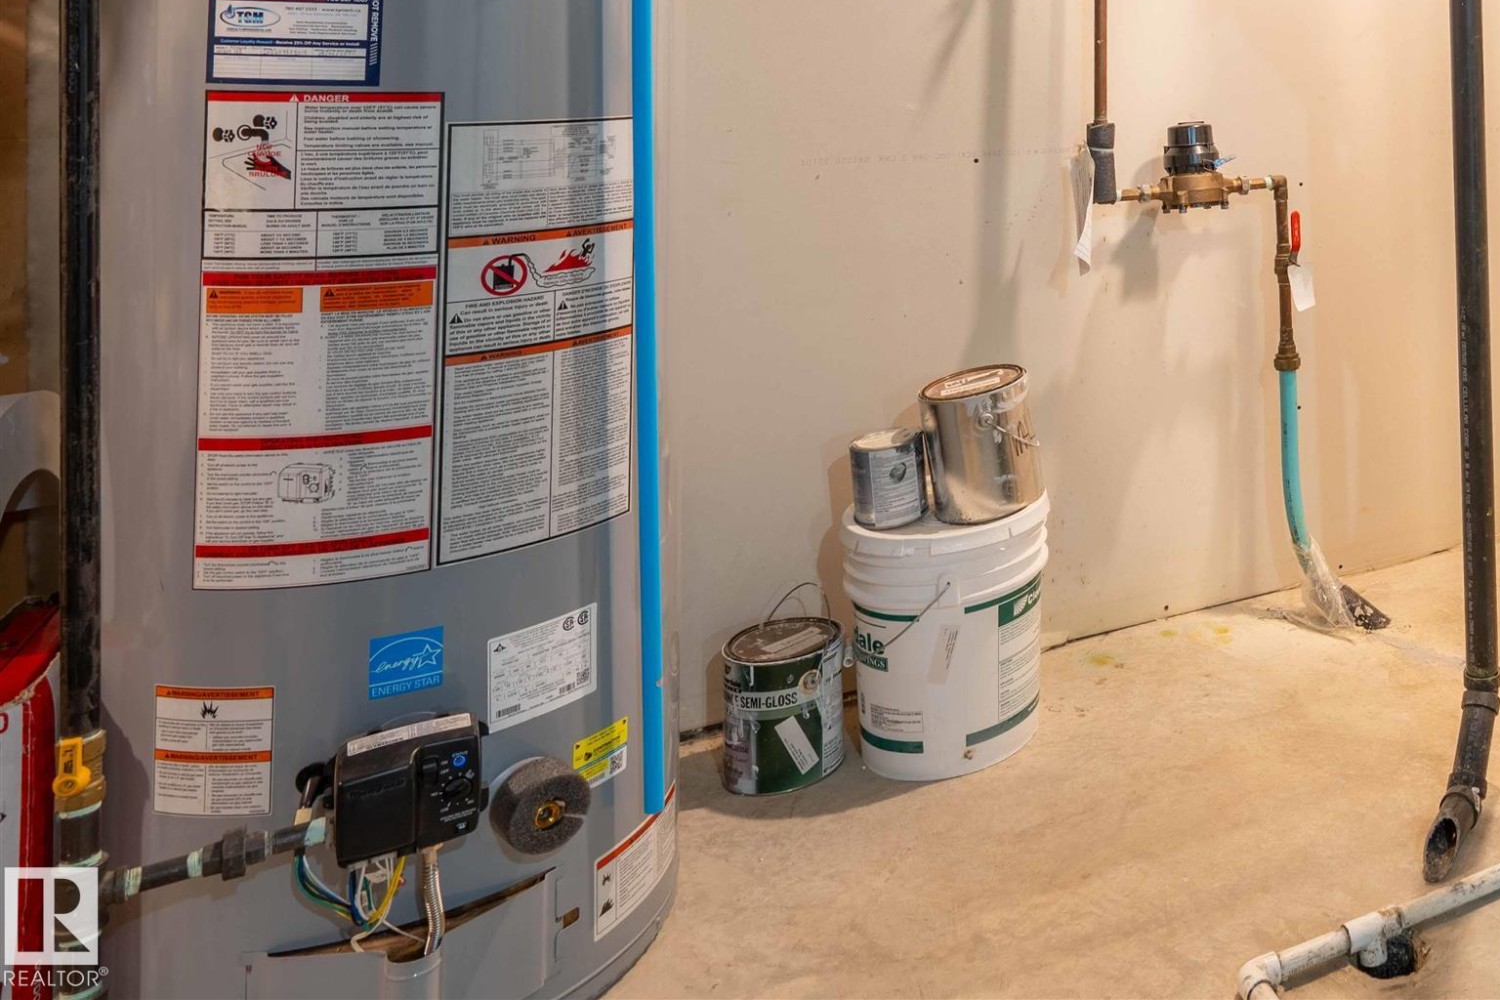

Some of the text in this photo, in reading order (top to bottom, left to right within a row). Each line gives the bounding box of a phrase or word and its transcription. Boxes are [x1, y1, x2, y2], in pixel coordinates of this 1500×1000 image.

[237, 11, 264, 24] TGM
[371, 12, 379, 42] REMOVE
[303, 94, 350, 103] DANGER
[491, 223, 627, 245] WARNING AVERTISSEMENT
[489, 350, 522, 360] WARNING
[371, 675, 441, 698] ENERGY STAR
[740, 692, 798, 710] SEMI-GLOSS
